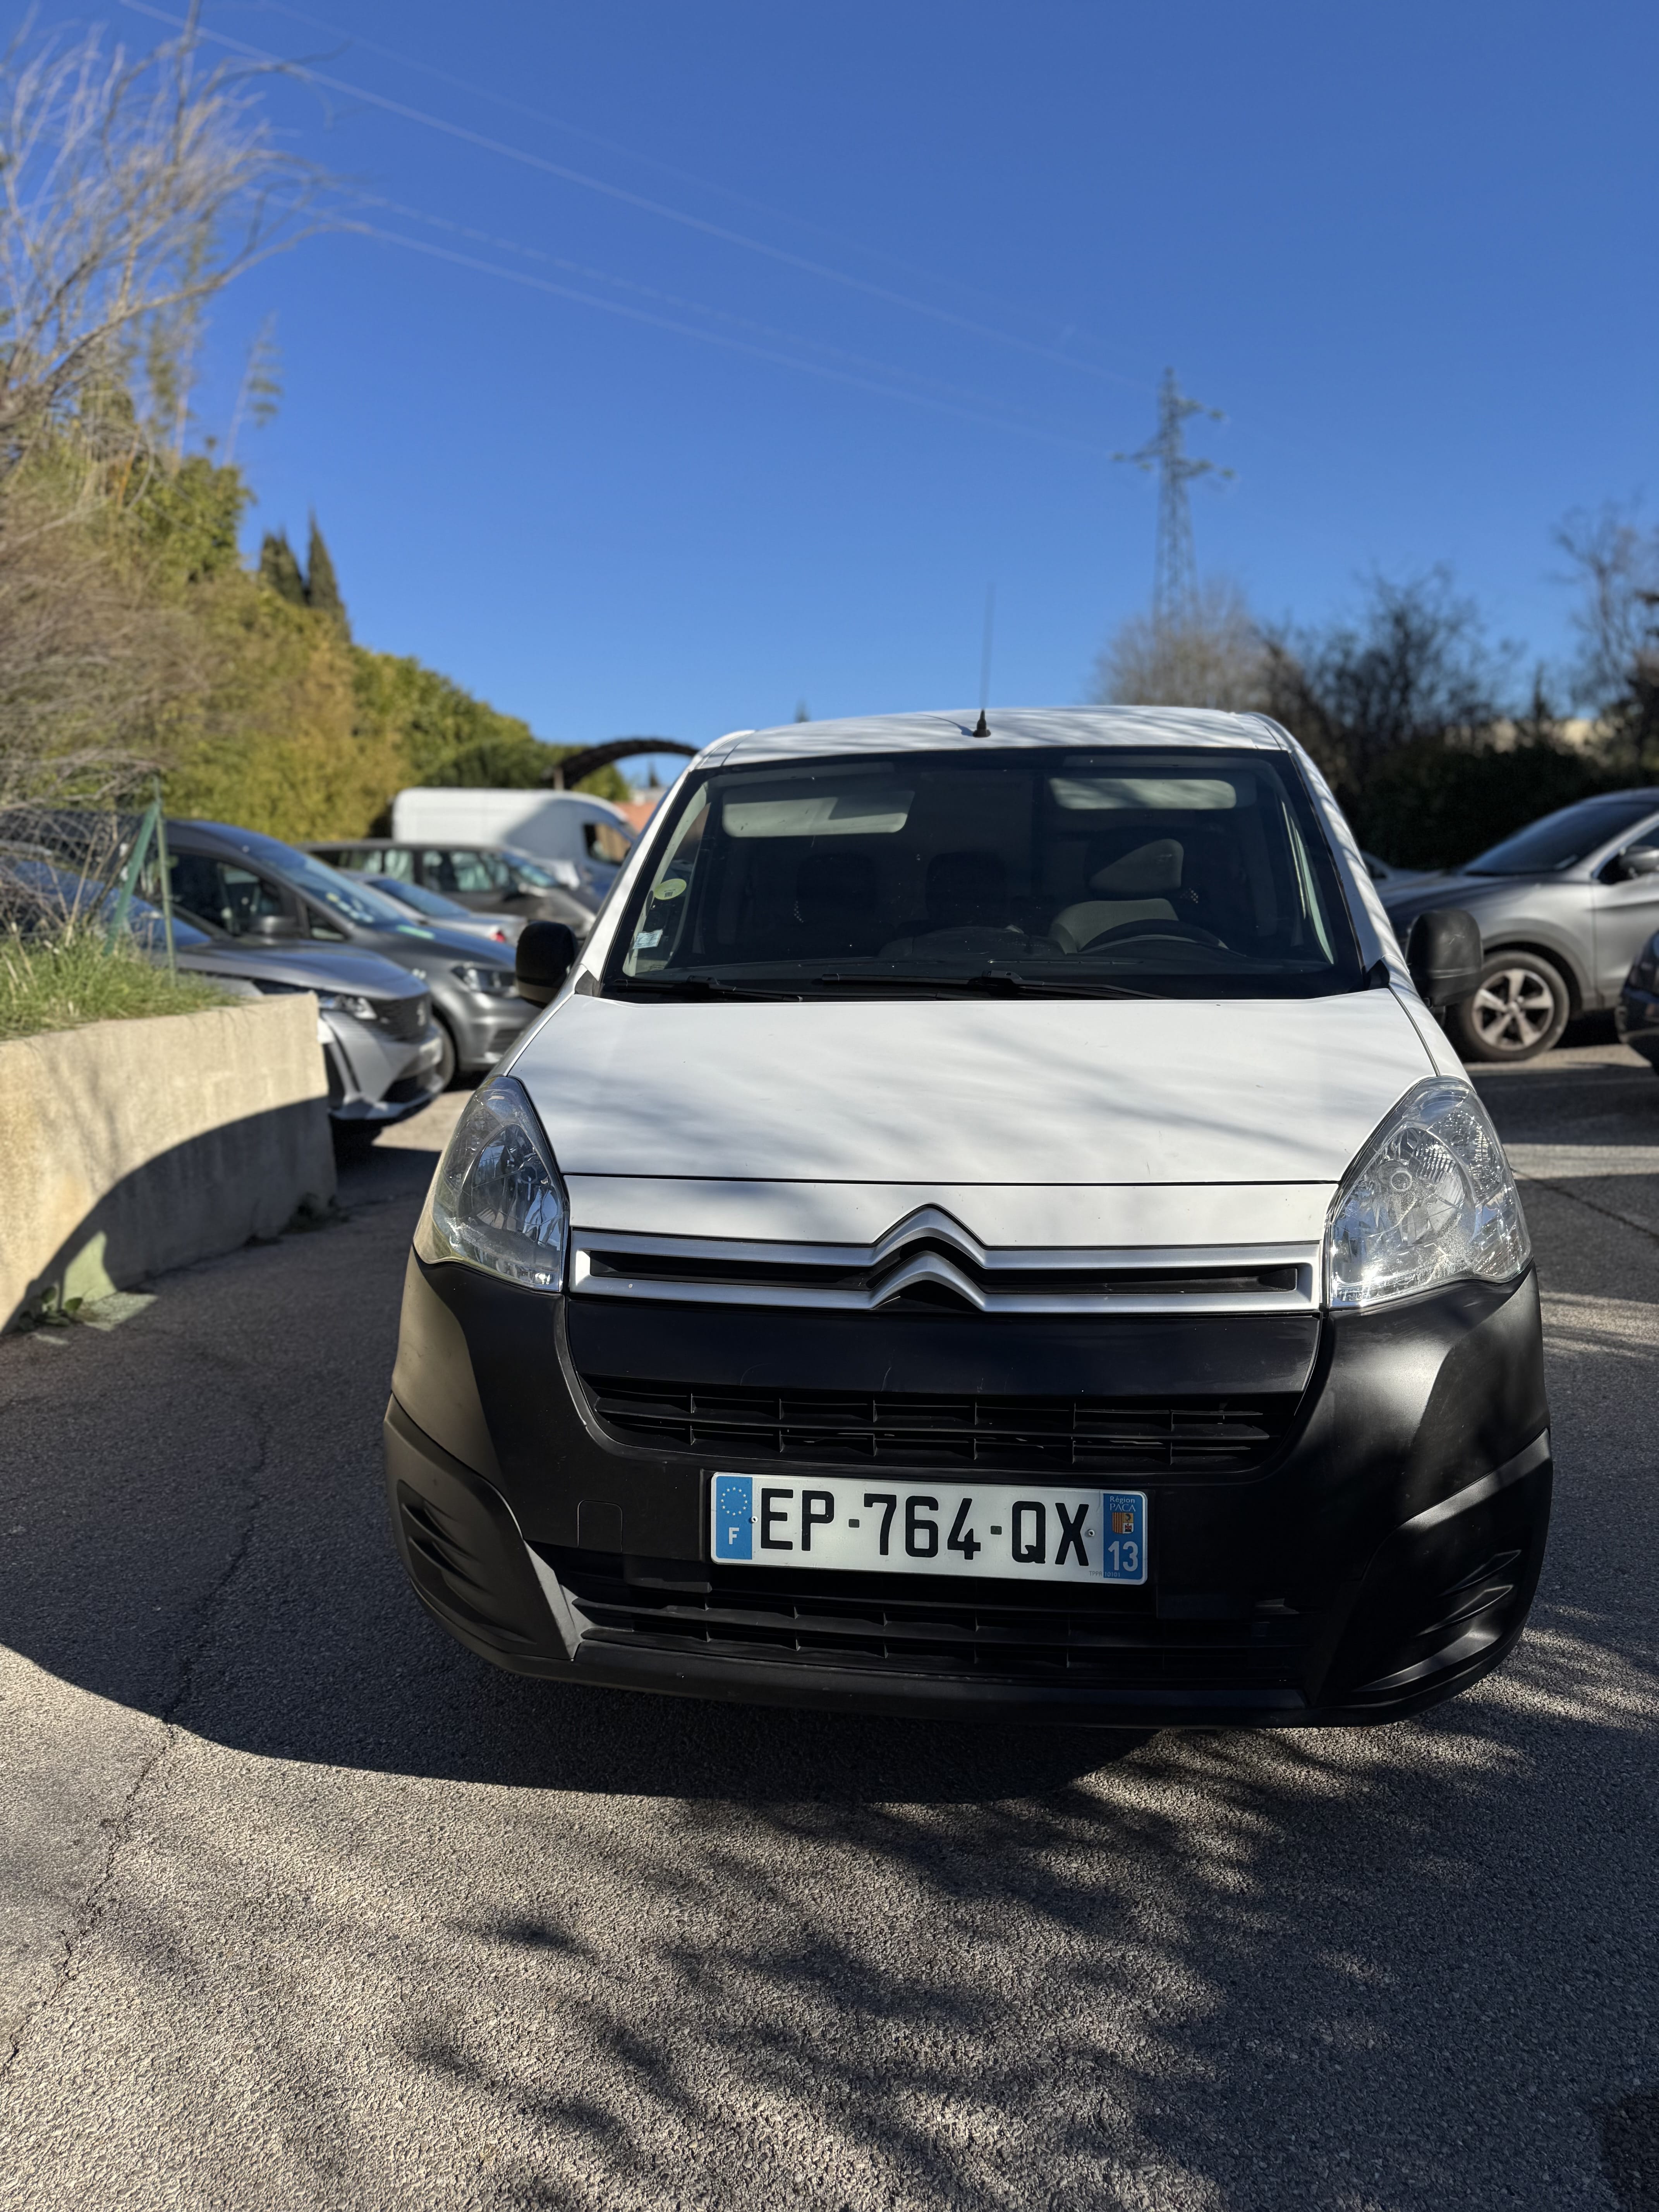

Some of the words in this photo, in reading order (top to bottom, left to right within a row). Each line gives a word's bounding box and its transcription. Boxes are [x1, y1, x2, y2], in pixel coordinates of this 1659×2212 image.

[1110, 1496, 1135, 1504] Région
[1110, 1503, 1135, 1512] PACA
[728, 1527, 739, 1544] F
[1108, 1540, 1138, 1571] 13
